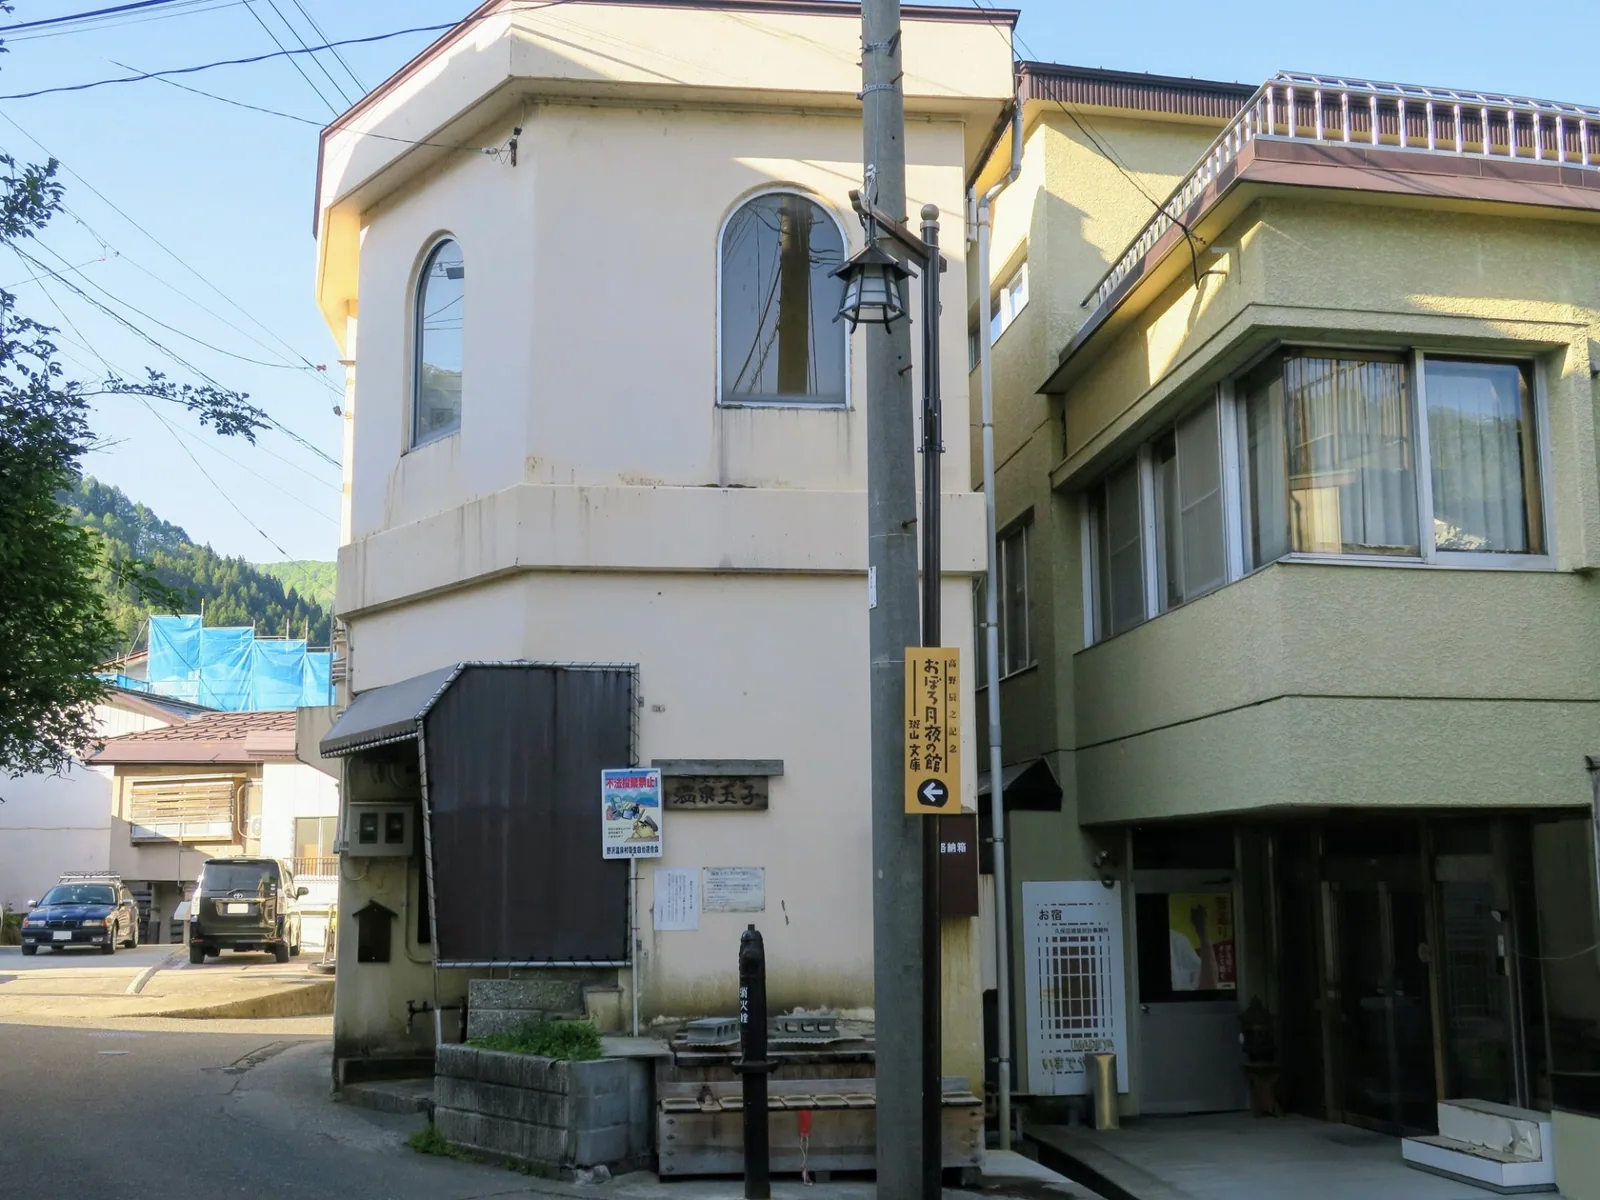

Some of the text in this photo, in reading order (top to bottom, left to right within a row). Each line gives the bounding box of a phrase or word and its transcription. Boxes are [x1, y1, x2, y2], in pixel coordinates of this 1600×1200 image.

[924, 658, 943, 773] おぼろ月夜の館
[948, 658, 958, 754] 高野辰之記念
[909, 719, 921, 772] 斑山文庫
[1038, 909, 1063, 921] お宿
[739, 987, 749, 1024] 消火栓
